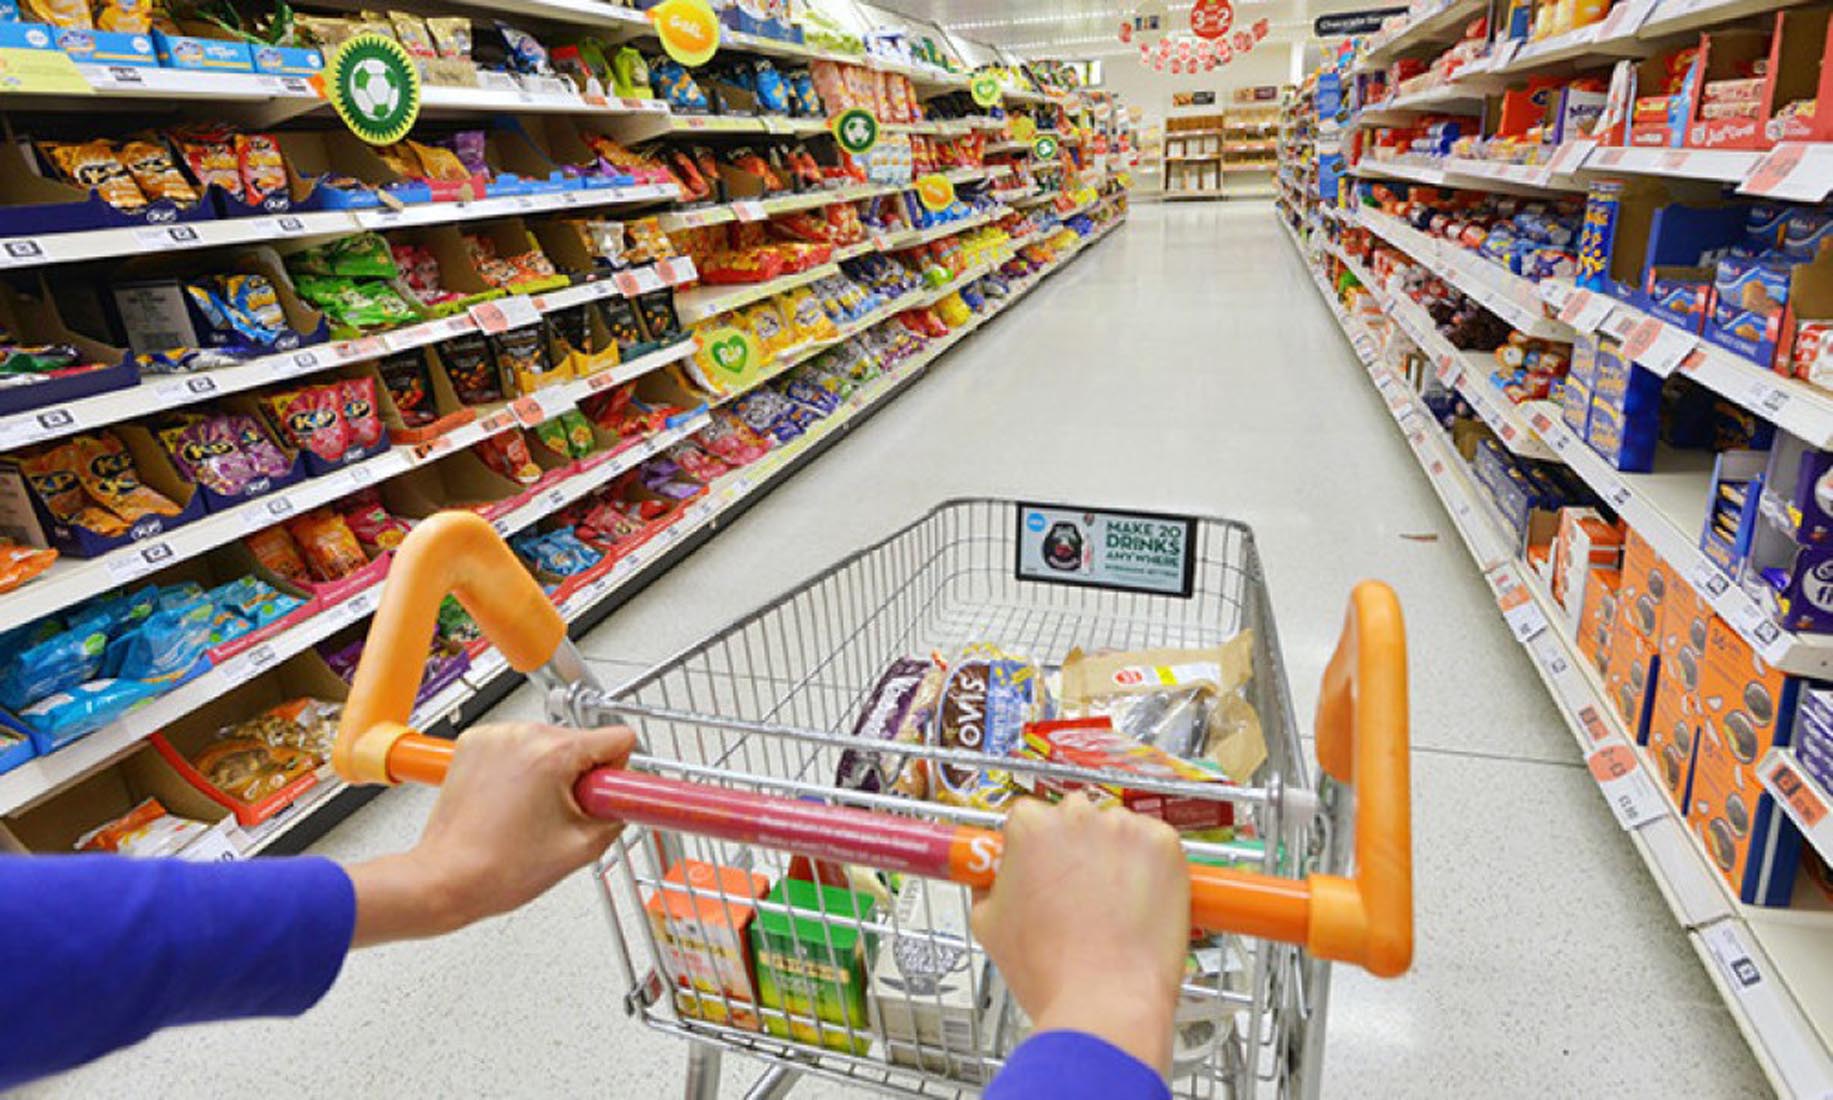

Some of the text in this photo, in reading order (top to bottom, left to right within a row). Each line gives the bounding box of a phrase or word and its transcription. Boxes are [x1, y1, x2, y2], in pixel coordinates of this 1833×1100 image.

[1106, 521, 1181, 538] MAKE 20
[1106, 534, 1180, 555] DRINKS
[1106, 551, 1178, 567] ANYWHERE
